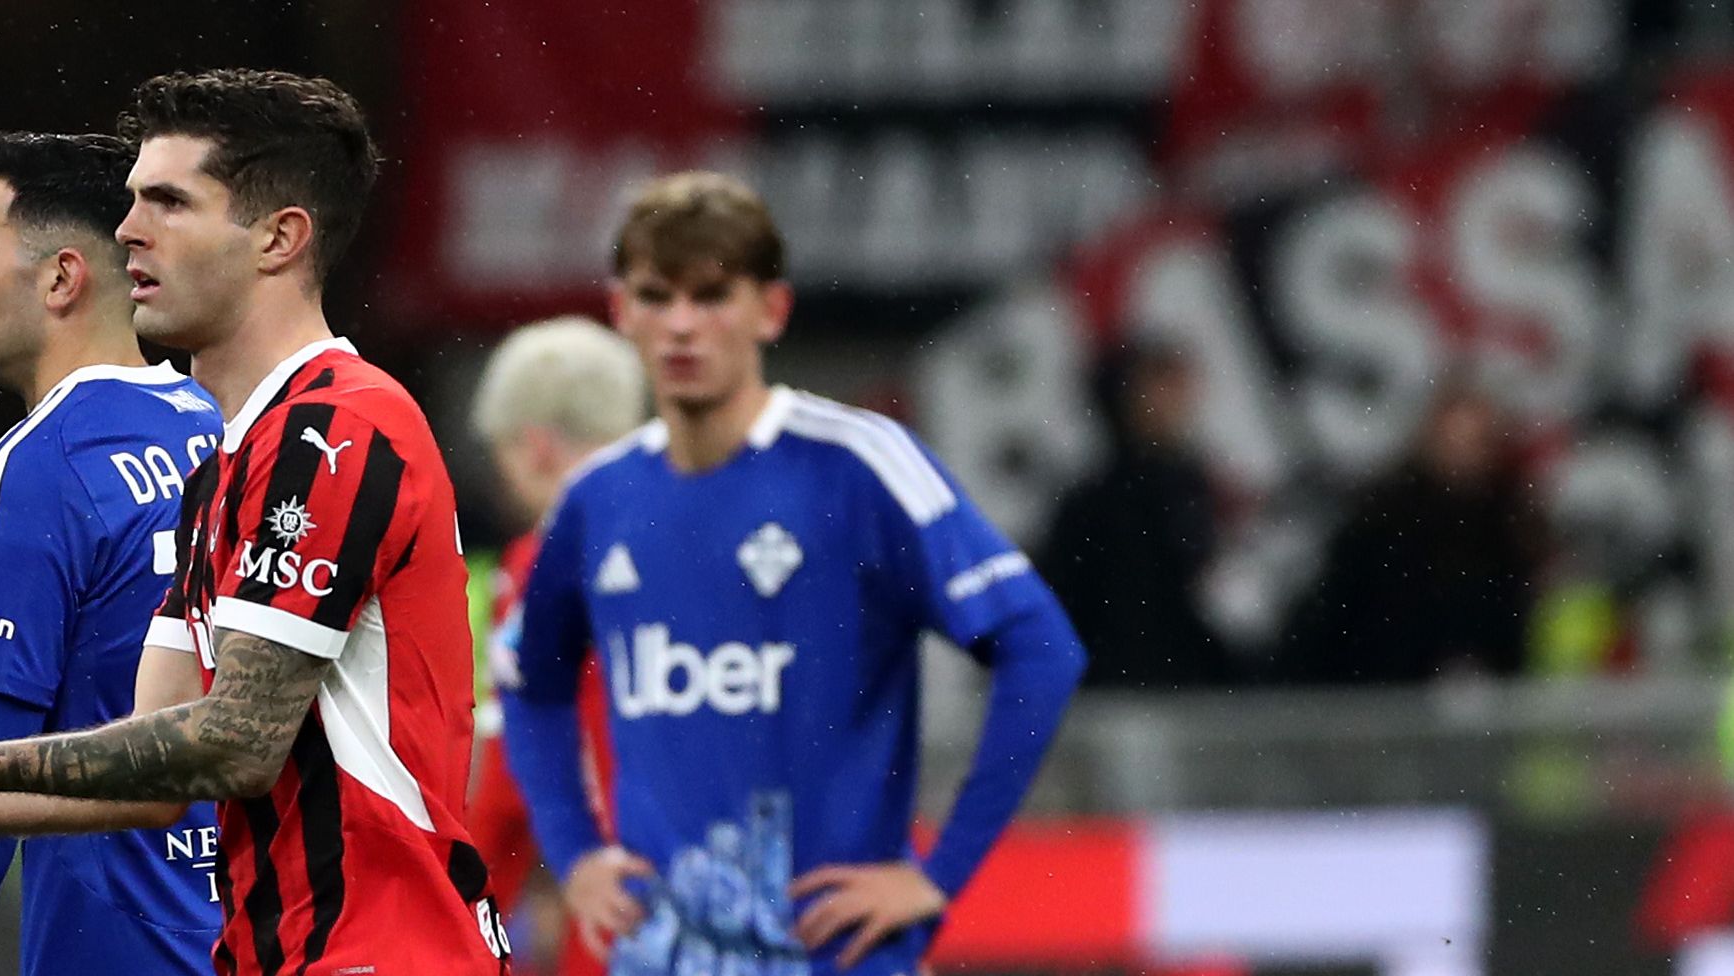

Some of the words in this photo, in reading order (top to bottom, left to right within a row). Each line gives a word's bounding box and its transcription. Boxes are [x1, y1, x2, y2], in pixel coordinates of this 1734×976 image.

[110, 445, 184, 505] DA
[187, 434, 218, 468] C
[235, 540, 339, 597] MSC
[607, 621, 796, 720] Uber
[166, 826, 220, 860] NE
